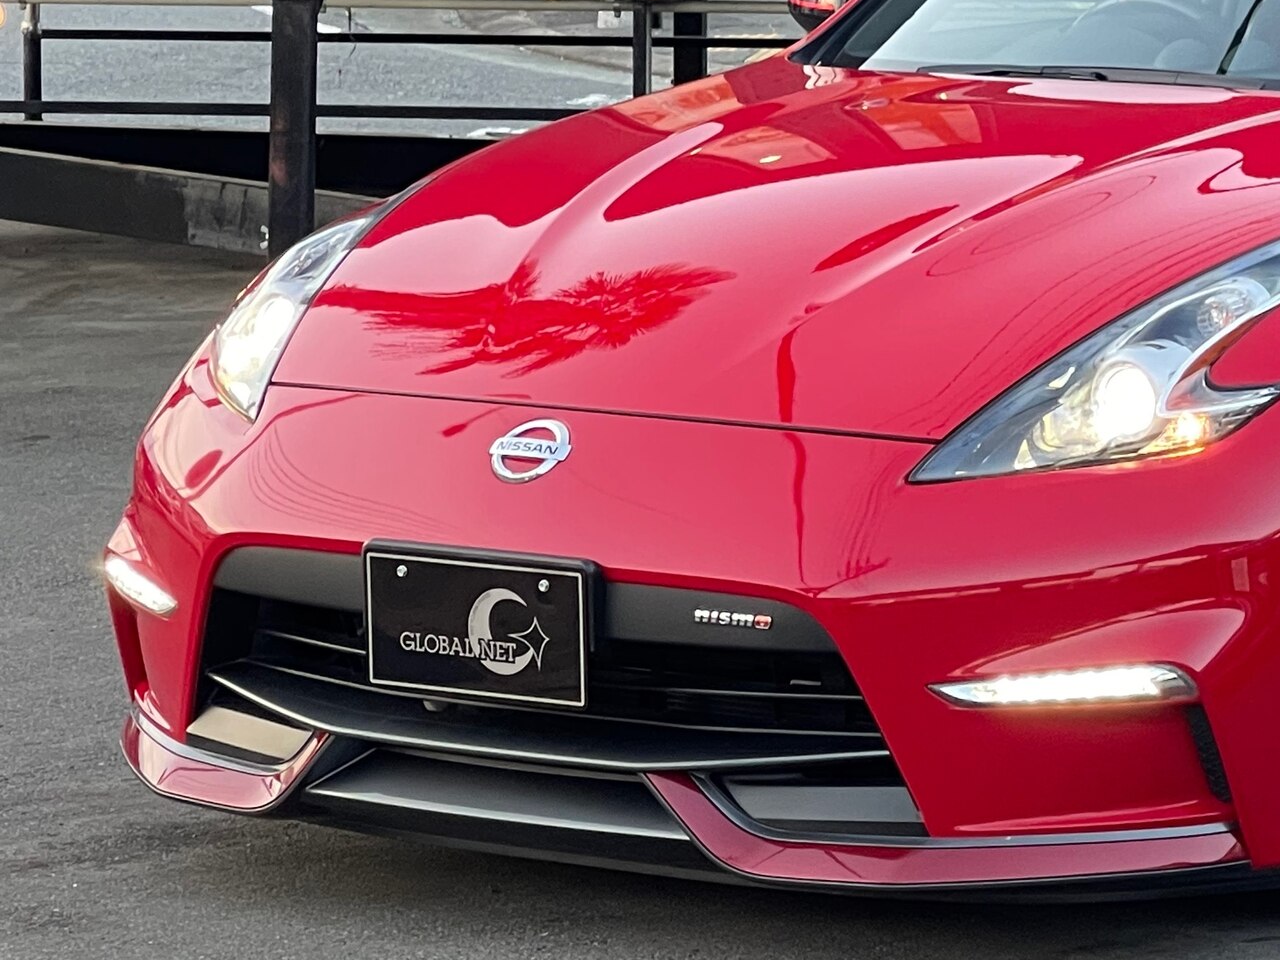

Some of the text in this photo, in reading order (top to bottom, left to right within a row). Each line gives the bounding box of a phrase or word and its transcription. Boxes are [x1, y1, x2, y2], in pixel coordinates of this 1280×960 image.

[496, 440, 559, 455] NISSAN
[400, 631, 517, 662] GLOBAL NET
